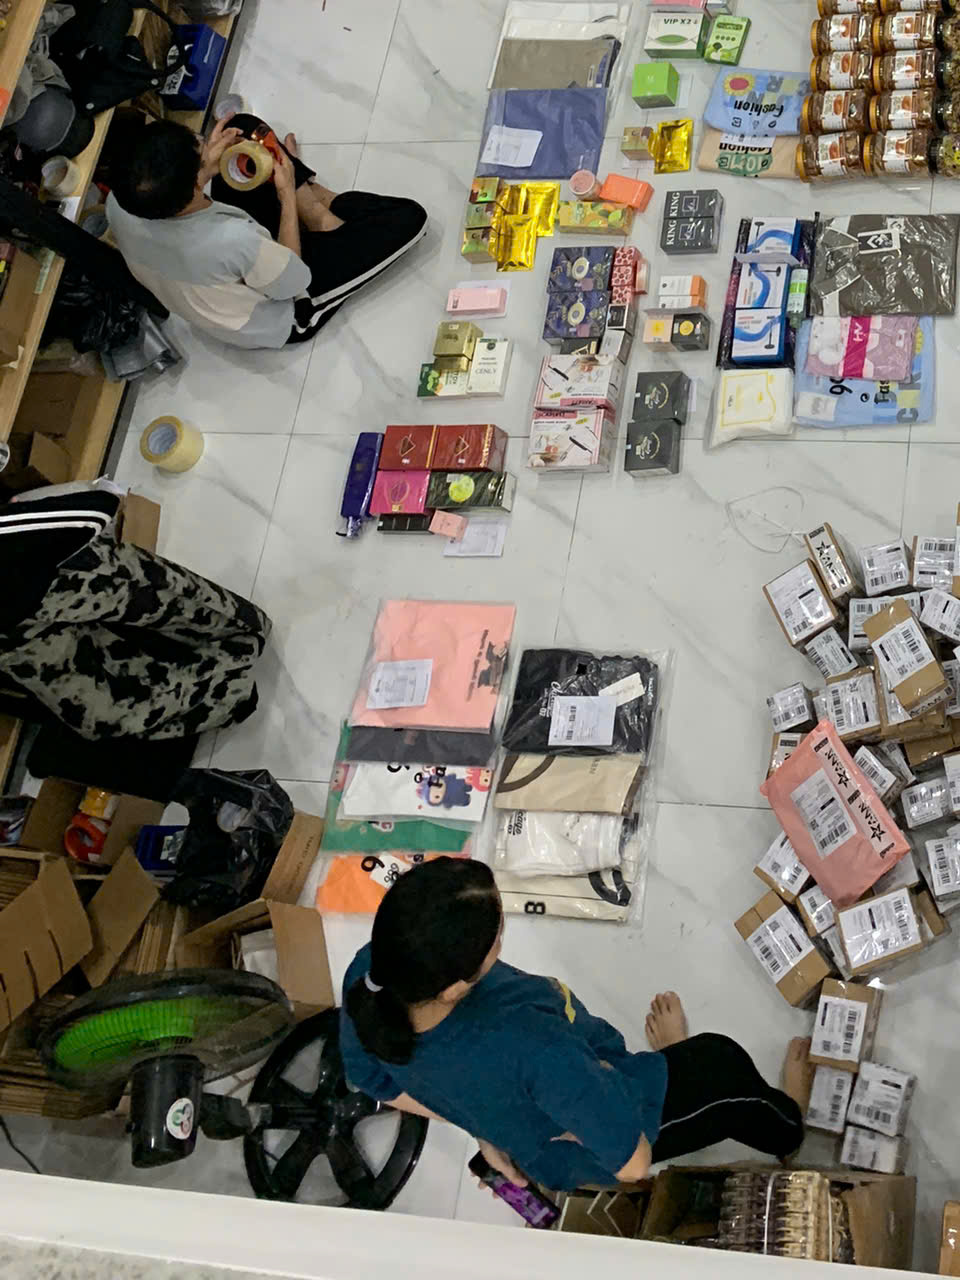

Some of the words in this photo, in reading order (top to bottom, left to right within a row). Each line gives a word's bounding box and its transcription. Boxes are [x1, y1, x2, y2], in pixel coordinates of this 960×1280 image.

[733, 100, 784, 118] Fashion
[669, 192, 681, 217] KING
[666, 220, 678, 246] KING
